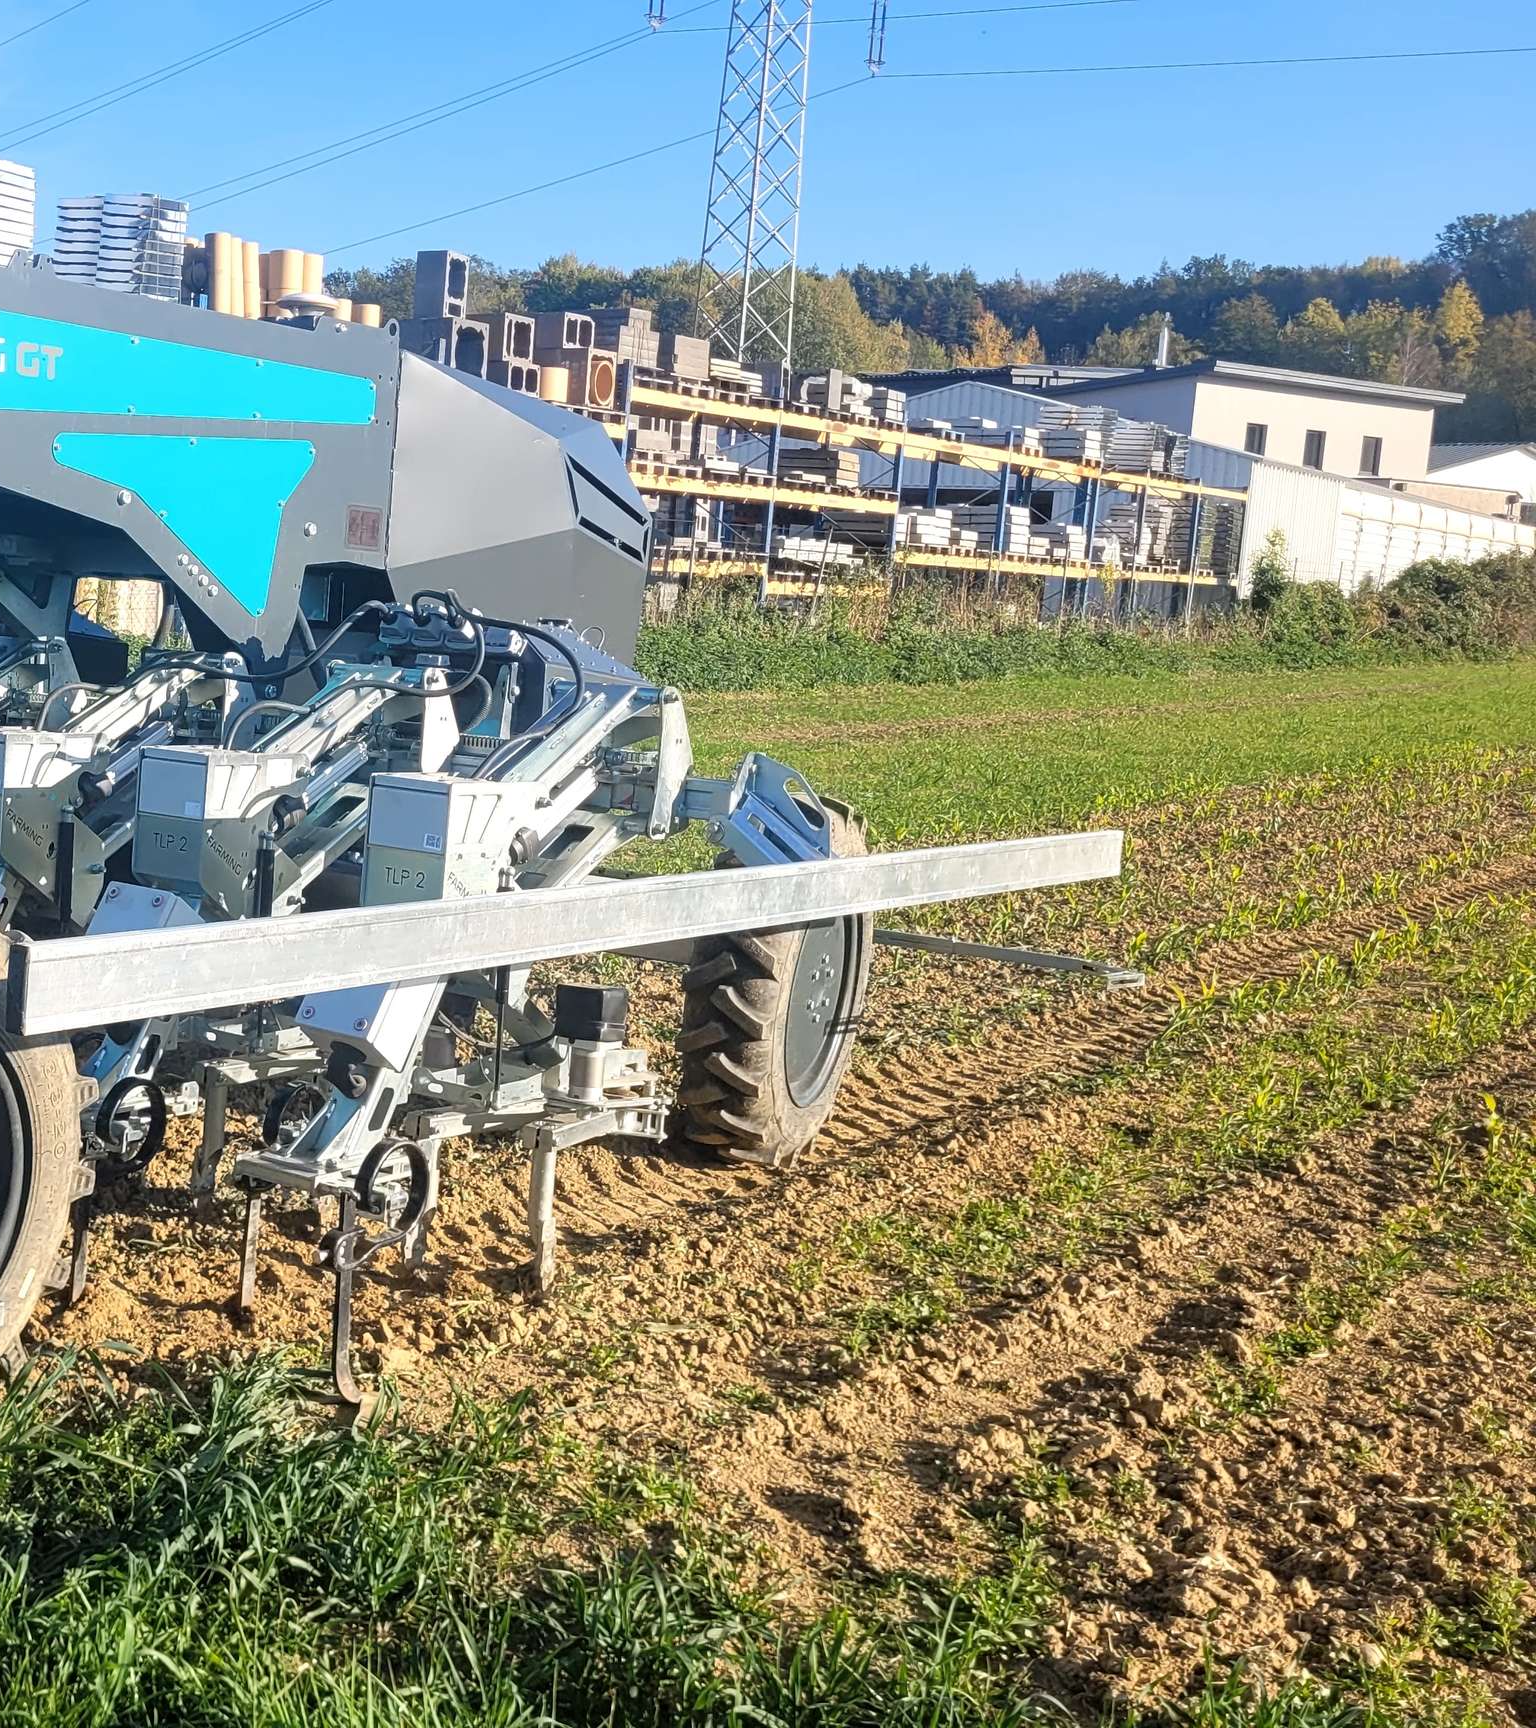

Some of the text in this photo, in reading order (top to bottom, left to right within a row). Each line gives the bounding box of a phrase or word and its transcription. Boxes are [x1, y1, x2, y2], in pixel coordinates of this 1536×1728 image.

[16, 341, 64, 381] GT
[6, 808, 44, 847] FARMING
[153, 832, 188, 852] TLP 2
[206, 835, 242, 876] FARMING
[385, 866, 425, 889] TLP 2
